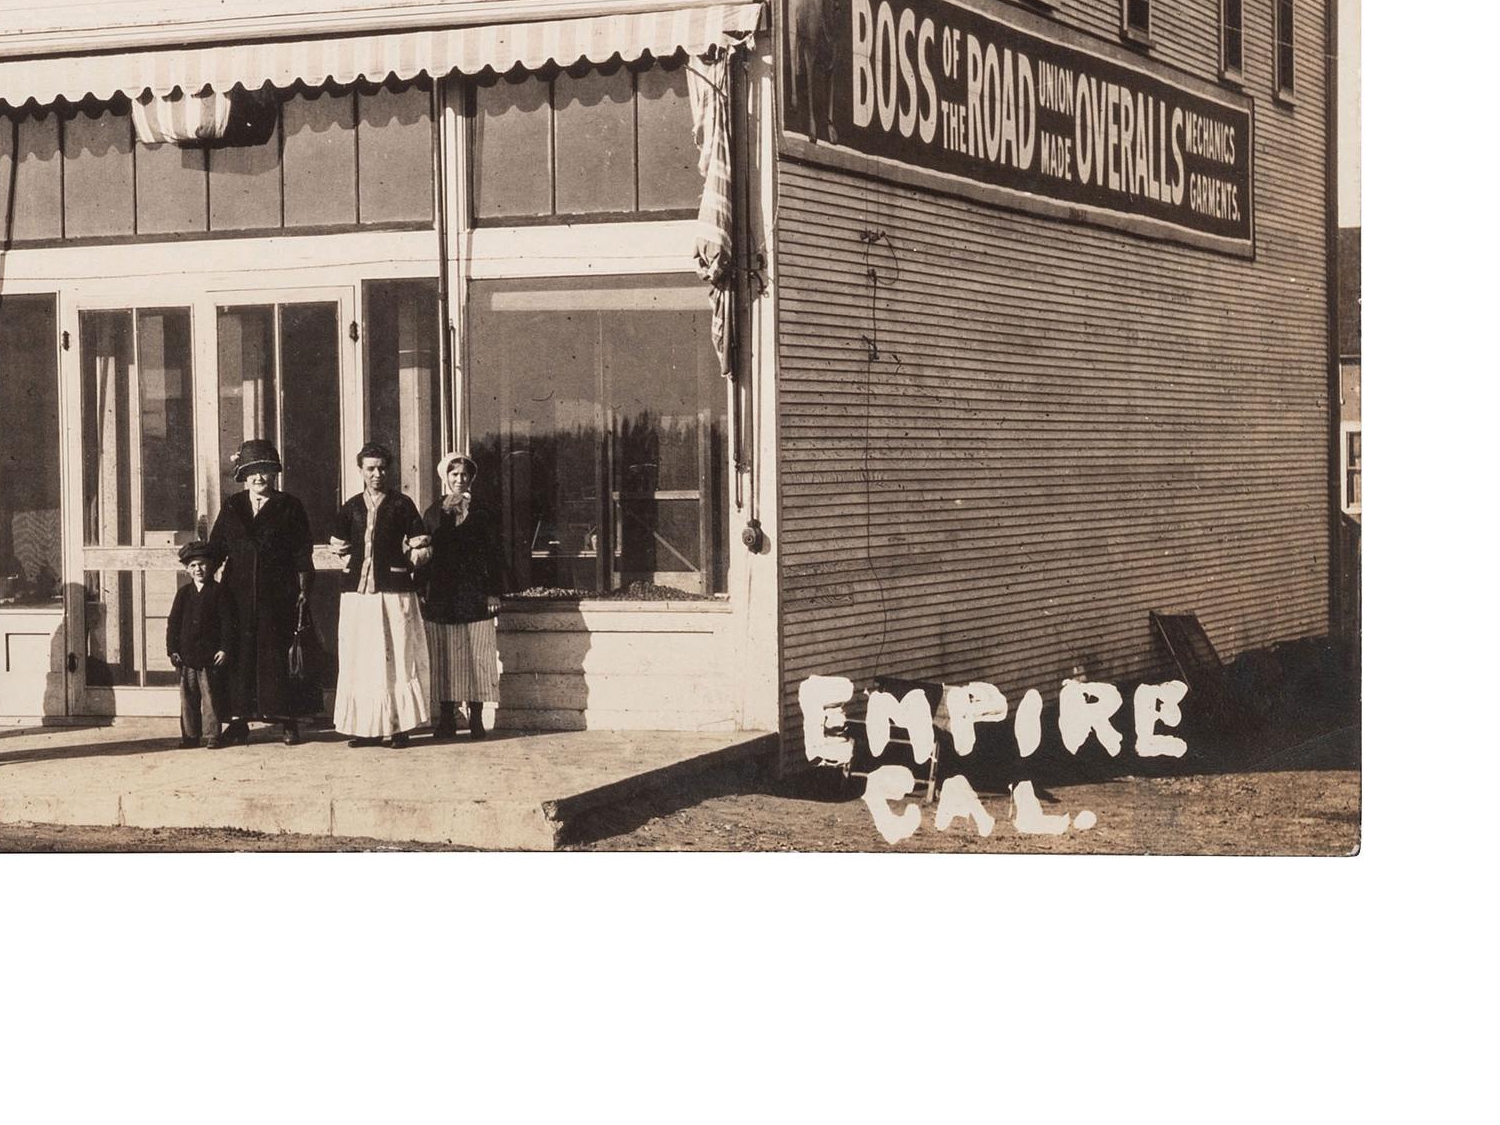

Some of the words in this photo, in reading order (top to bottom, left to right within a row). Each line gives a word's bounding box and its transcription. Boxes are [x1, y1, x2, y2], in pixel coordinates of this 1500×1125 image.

[942, 25, 960, 77] OF
[967, 33, 1036, 170] ROAD
[1038, 60, 1075, 116] UNION
[941, 100, 967, 153] THE
[1075, 72, 1184, 206] OVERALLS
[1185, 110, 1236, 165] MECHANICS
[1040, 131, 1073, 181] MADE
